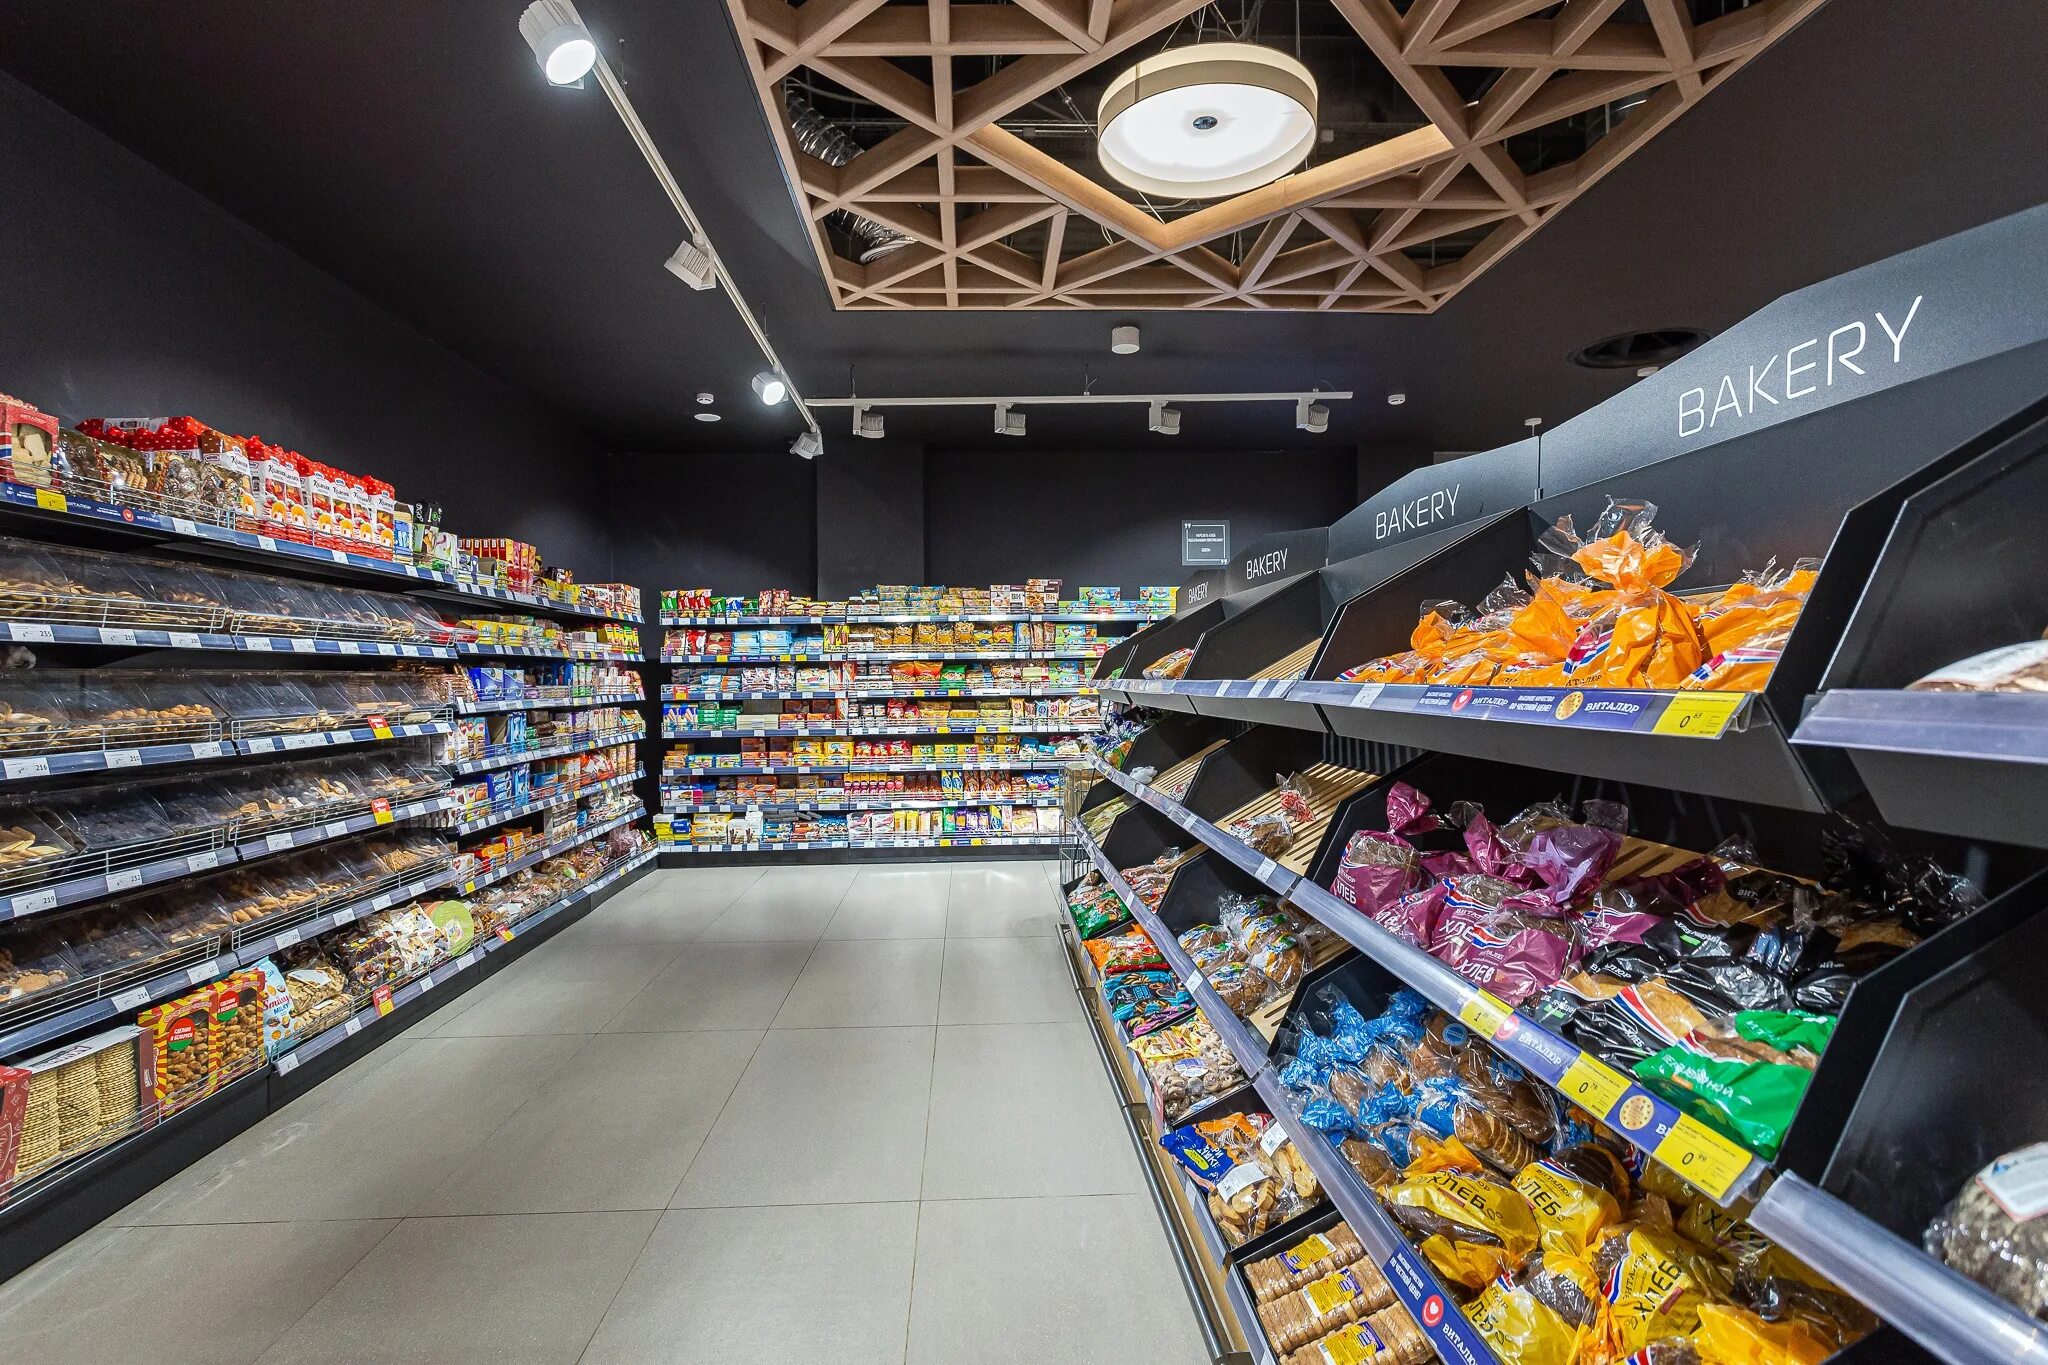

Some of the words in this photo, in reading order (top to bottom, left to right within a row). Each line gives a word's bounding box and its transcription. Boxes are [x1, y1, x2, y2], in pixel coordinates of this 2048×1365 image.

[1678, 294, 1923, 438] BAKERY
[1375, 483, 1461, 540] BAKERY
[1246, 547, 1289, 581] BAKERY
[1187, 580, 1210, 605] BAKERY
[1471, 696, 1510, 707] ВИТАЛЮР
[1584, 701, 1640, 713] ВИТАЛЮР
[35, 764, 48, 772] 216
[43, 896, 55, 904] 219
[1518, 1033, 1562, 1065] ВИТАЛЮР
[1426, 1176, 1487, 1210] ХЛЕБ
[1518, 1179, 1562, 1216] ЛЕБ
[1633, 1260, 1682, 1322] ХЛЕБ
[1442, 1323, 1477, 1365] ВИТАЛЮ
